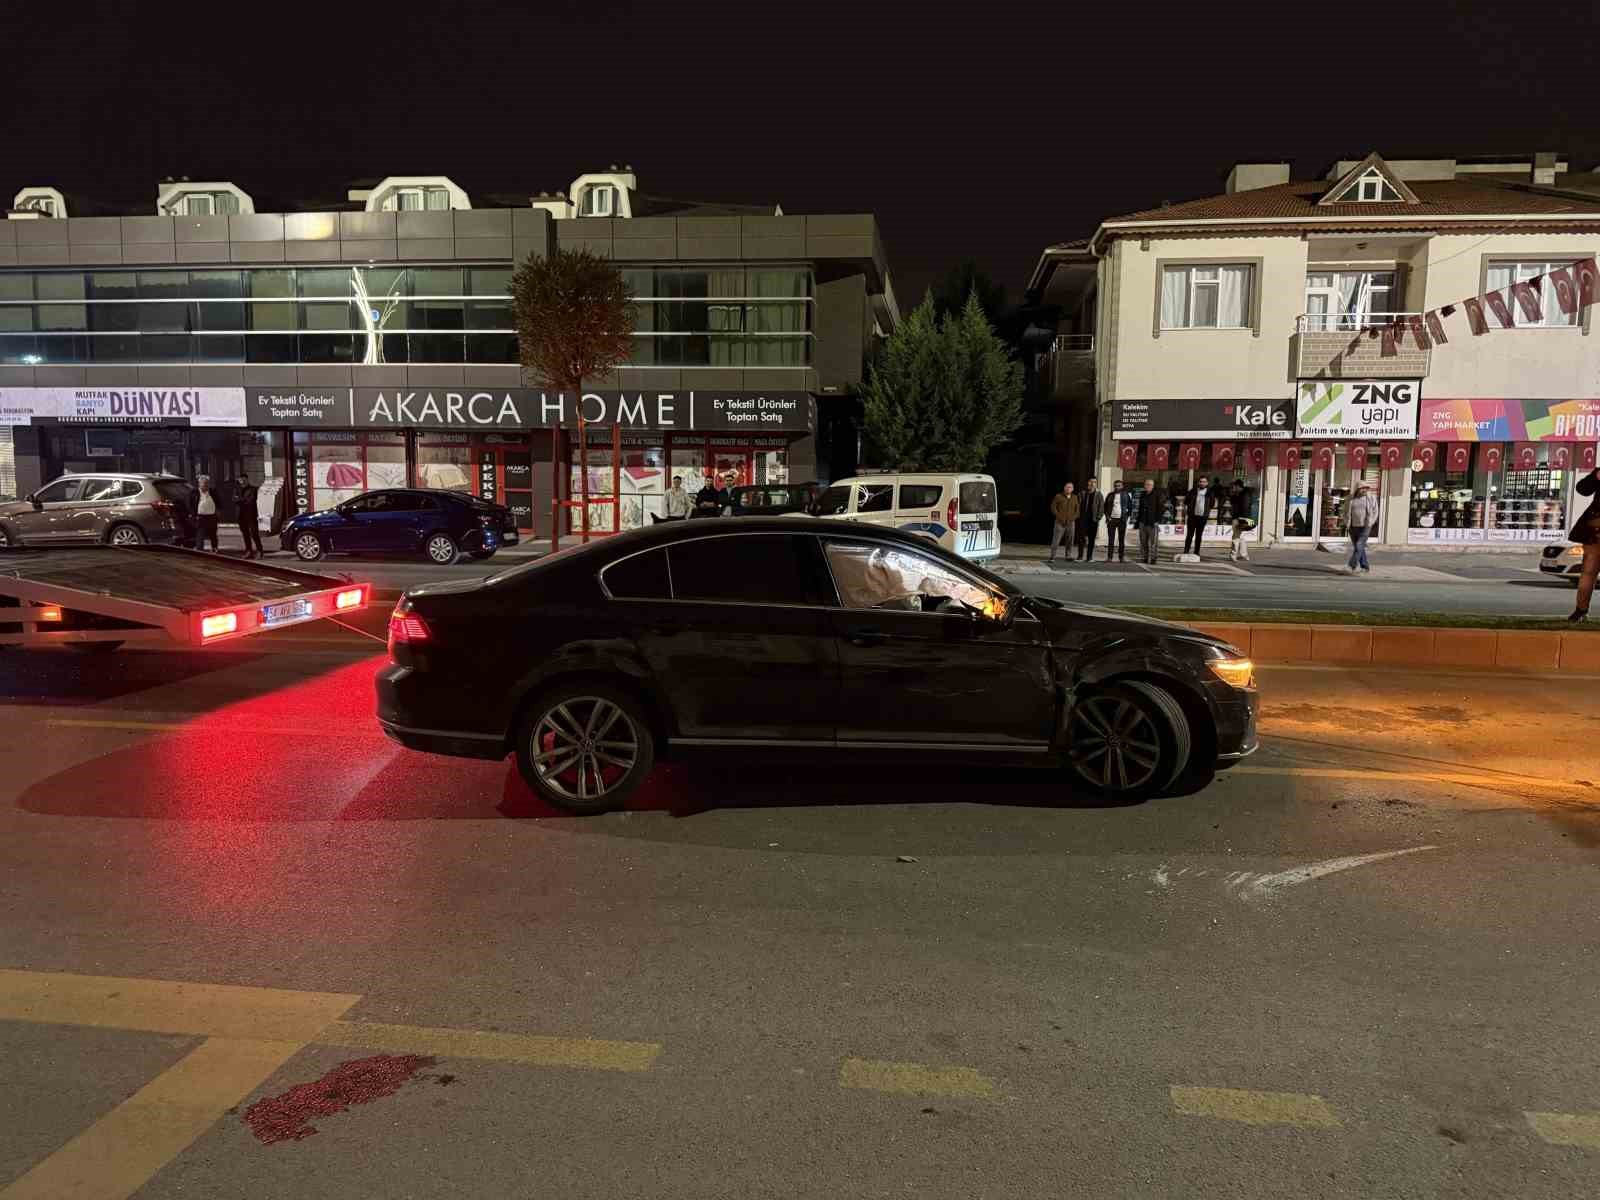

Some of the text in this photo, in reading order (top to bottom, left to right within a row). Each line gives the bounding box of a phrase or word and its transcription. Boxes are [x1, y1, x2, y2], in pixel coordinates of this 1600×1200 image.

[75, 391, 108, 399] MUTFAK
[258, 393, 335, 405] Ev Tekstil Ürünleri
[1351, 384, 1411, 404] ZNG
[109, 391, 201, 416] DÜNYASI
[369, 392, 675, 425] AKARCA HOME
[713, 397, 796, 409] Ev Tekstil Ürünleri
[270, 407, 300, 419] Toptan
[726, 411, 783, 424] Toptan Satış
[1235, 405, 1287, 425] Kale
[1361, 408, 1399, 424] yapı
